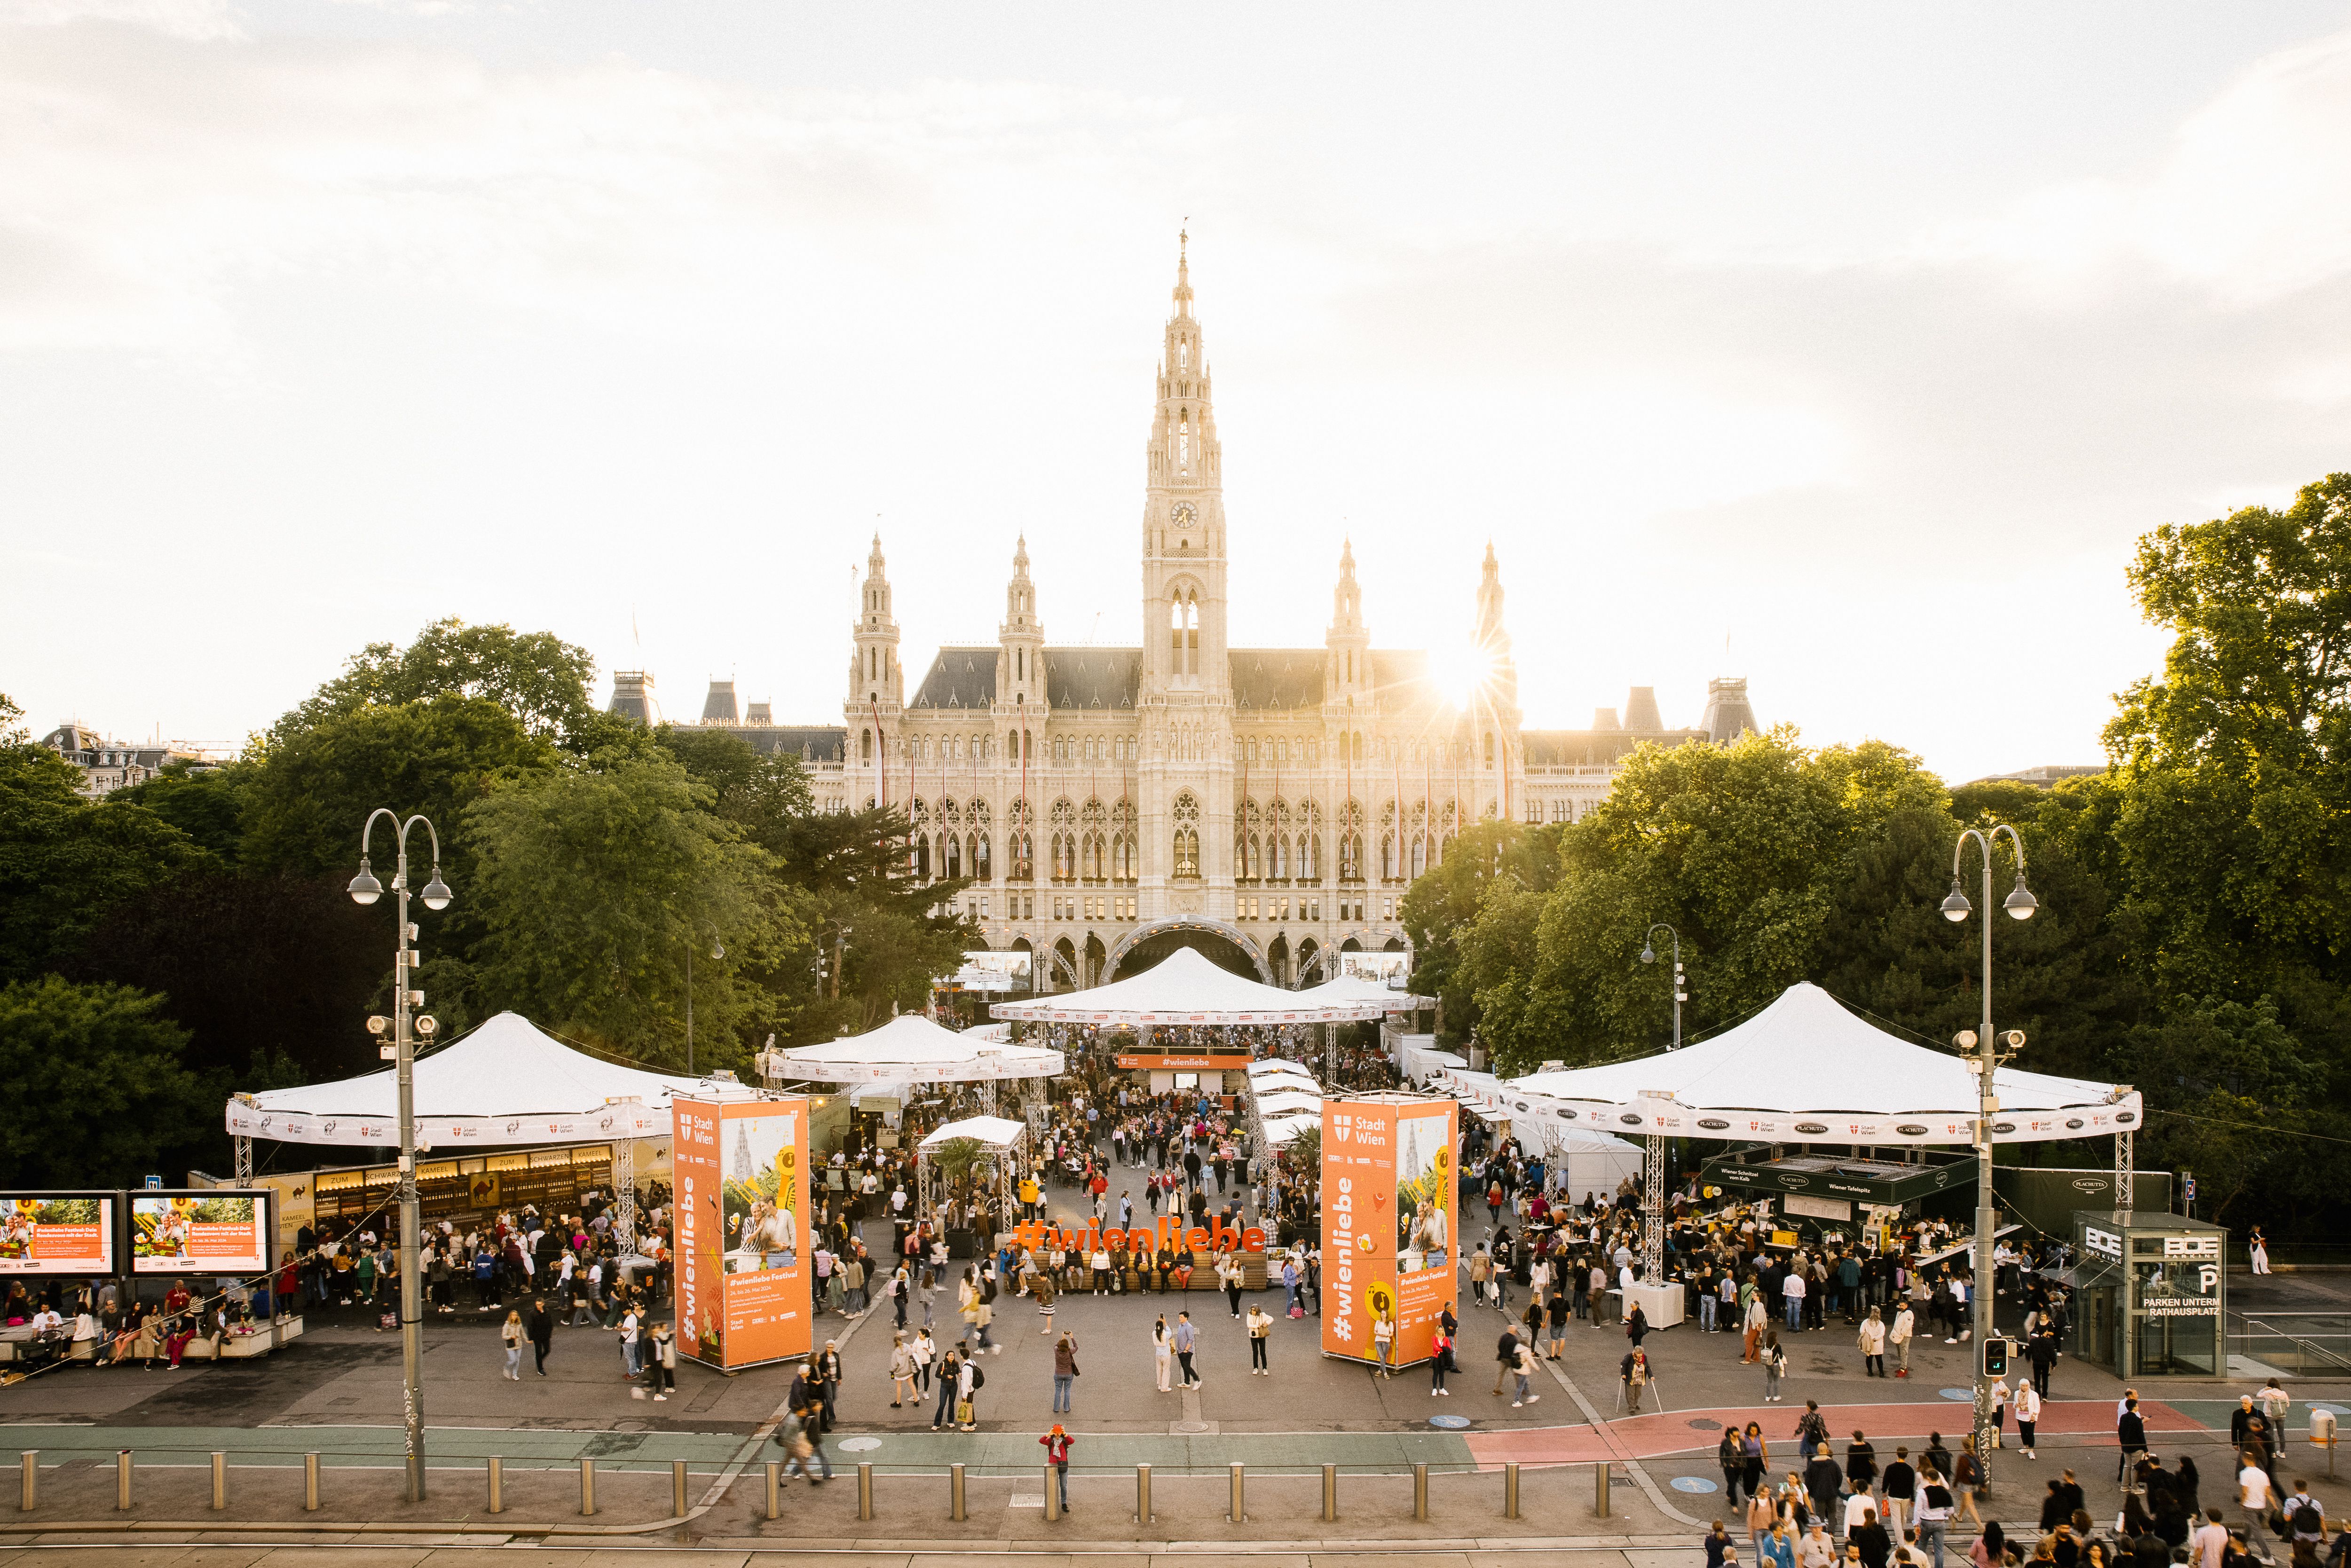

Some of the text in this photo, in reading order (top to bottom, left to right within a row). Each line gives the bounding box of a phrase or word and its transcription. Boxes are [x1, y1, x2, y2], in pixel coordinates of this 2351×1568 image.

[694, 1115, 713, 1131] Stadt
[1356, 1116, 1385, 1131] Stadt
[694, 1130, 714, 1145] Wien
[1356, 1130, 1385, 1146] Wien
[530, 1154, 569, 1163] SCHWARZEN
[366, 1171, 401, 1180] SCHWARZ
[1011, 1215, 1265, 1253] #wienliebe
[2086, 1226, 2122, 1257] BOE
[2164, 1237, 2218, 1254] BOE
[681, 1176, 696, 1342] #wienliebe
[1333, 1177, 1352, 1342] #wienliebe
[2086, 1248, 2122, 1265] PARKING
[730, 1270, 798, 1287] #wienliebe Festival
[1401, 1269, 1448, 1286] #wienliebe Festival
[2201, 1271, 2217, 1293] P
[2150, 1307, 2219, 1316] RATHAUSPLATZ
